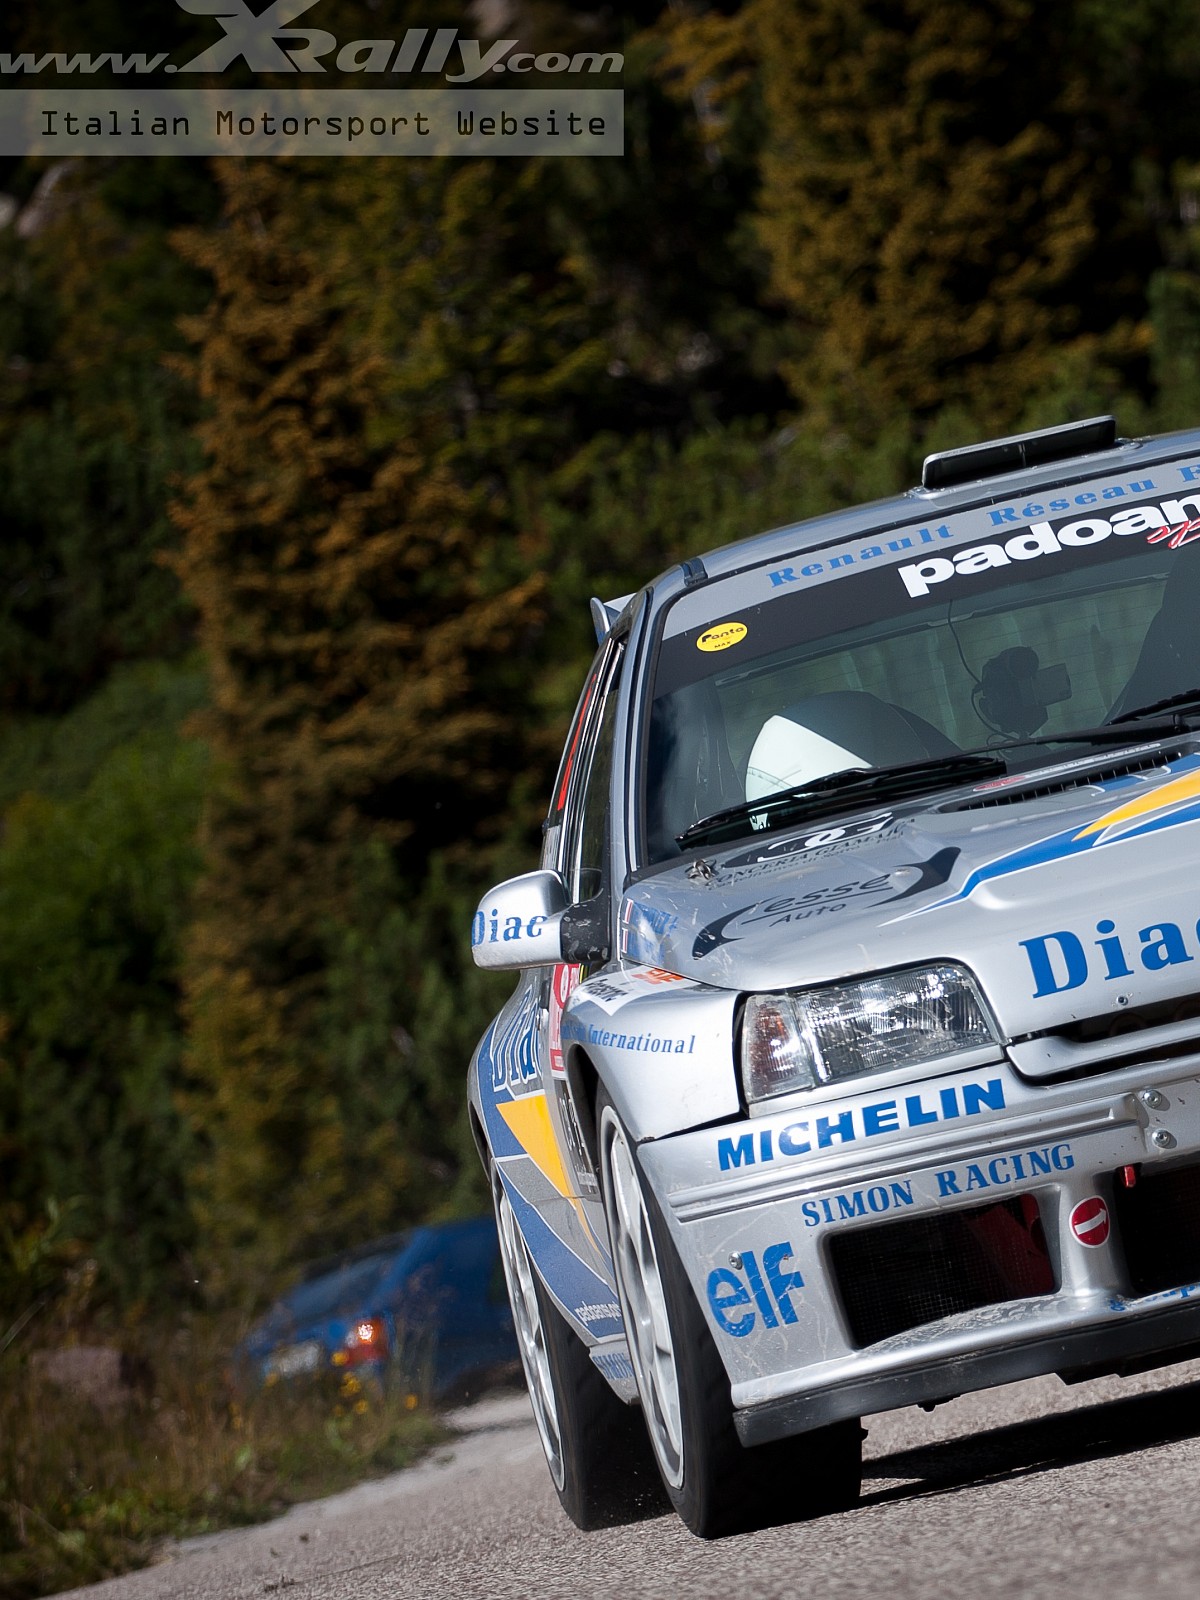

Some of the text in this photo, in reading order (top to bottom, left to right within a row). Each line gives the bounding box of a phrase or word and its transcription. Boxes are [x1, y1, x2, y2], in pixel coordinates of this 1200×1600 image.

[765, 522, 955, 588] Renault
[986, 474, 1158, 529] Réseau
[471, 908, 548, 946] Diac
[587, 1023, 697, 1054] International
[717, 1078, 1007, 1172] MICHELIN
[800, 1143, 1076, 1228] SIMON RACING
[705, 1240, 806, 1338] elf
